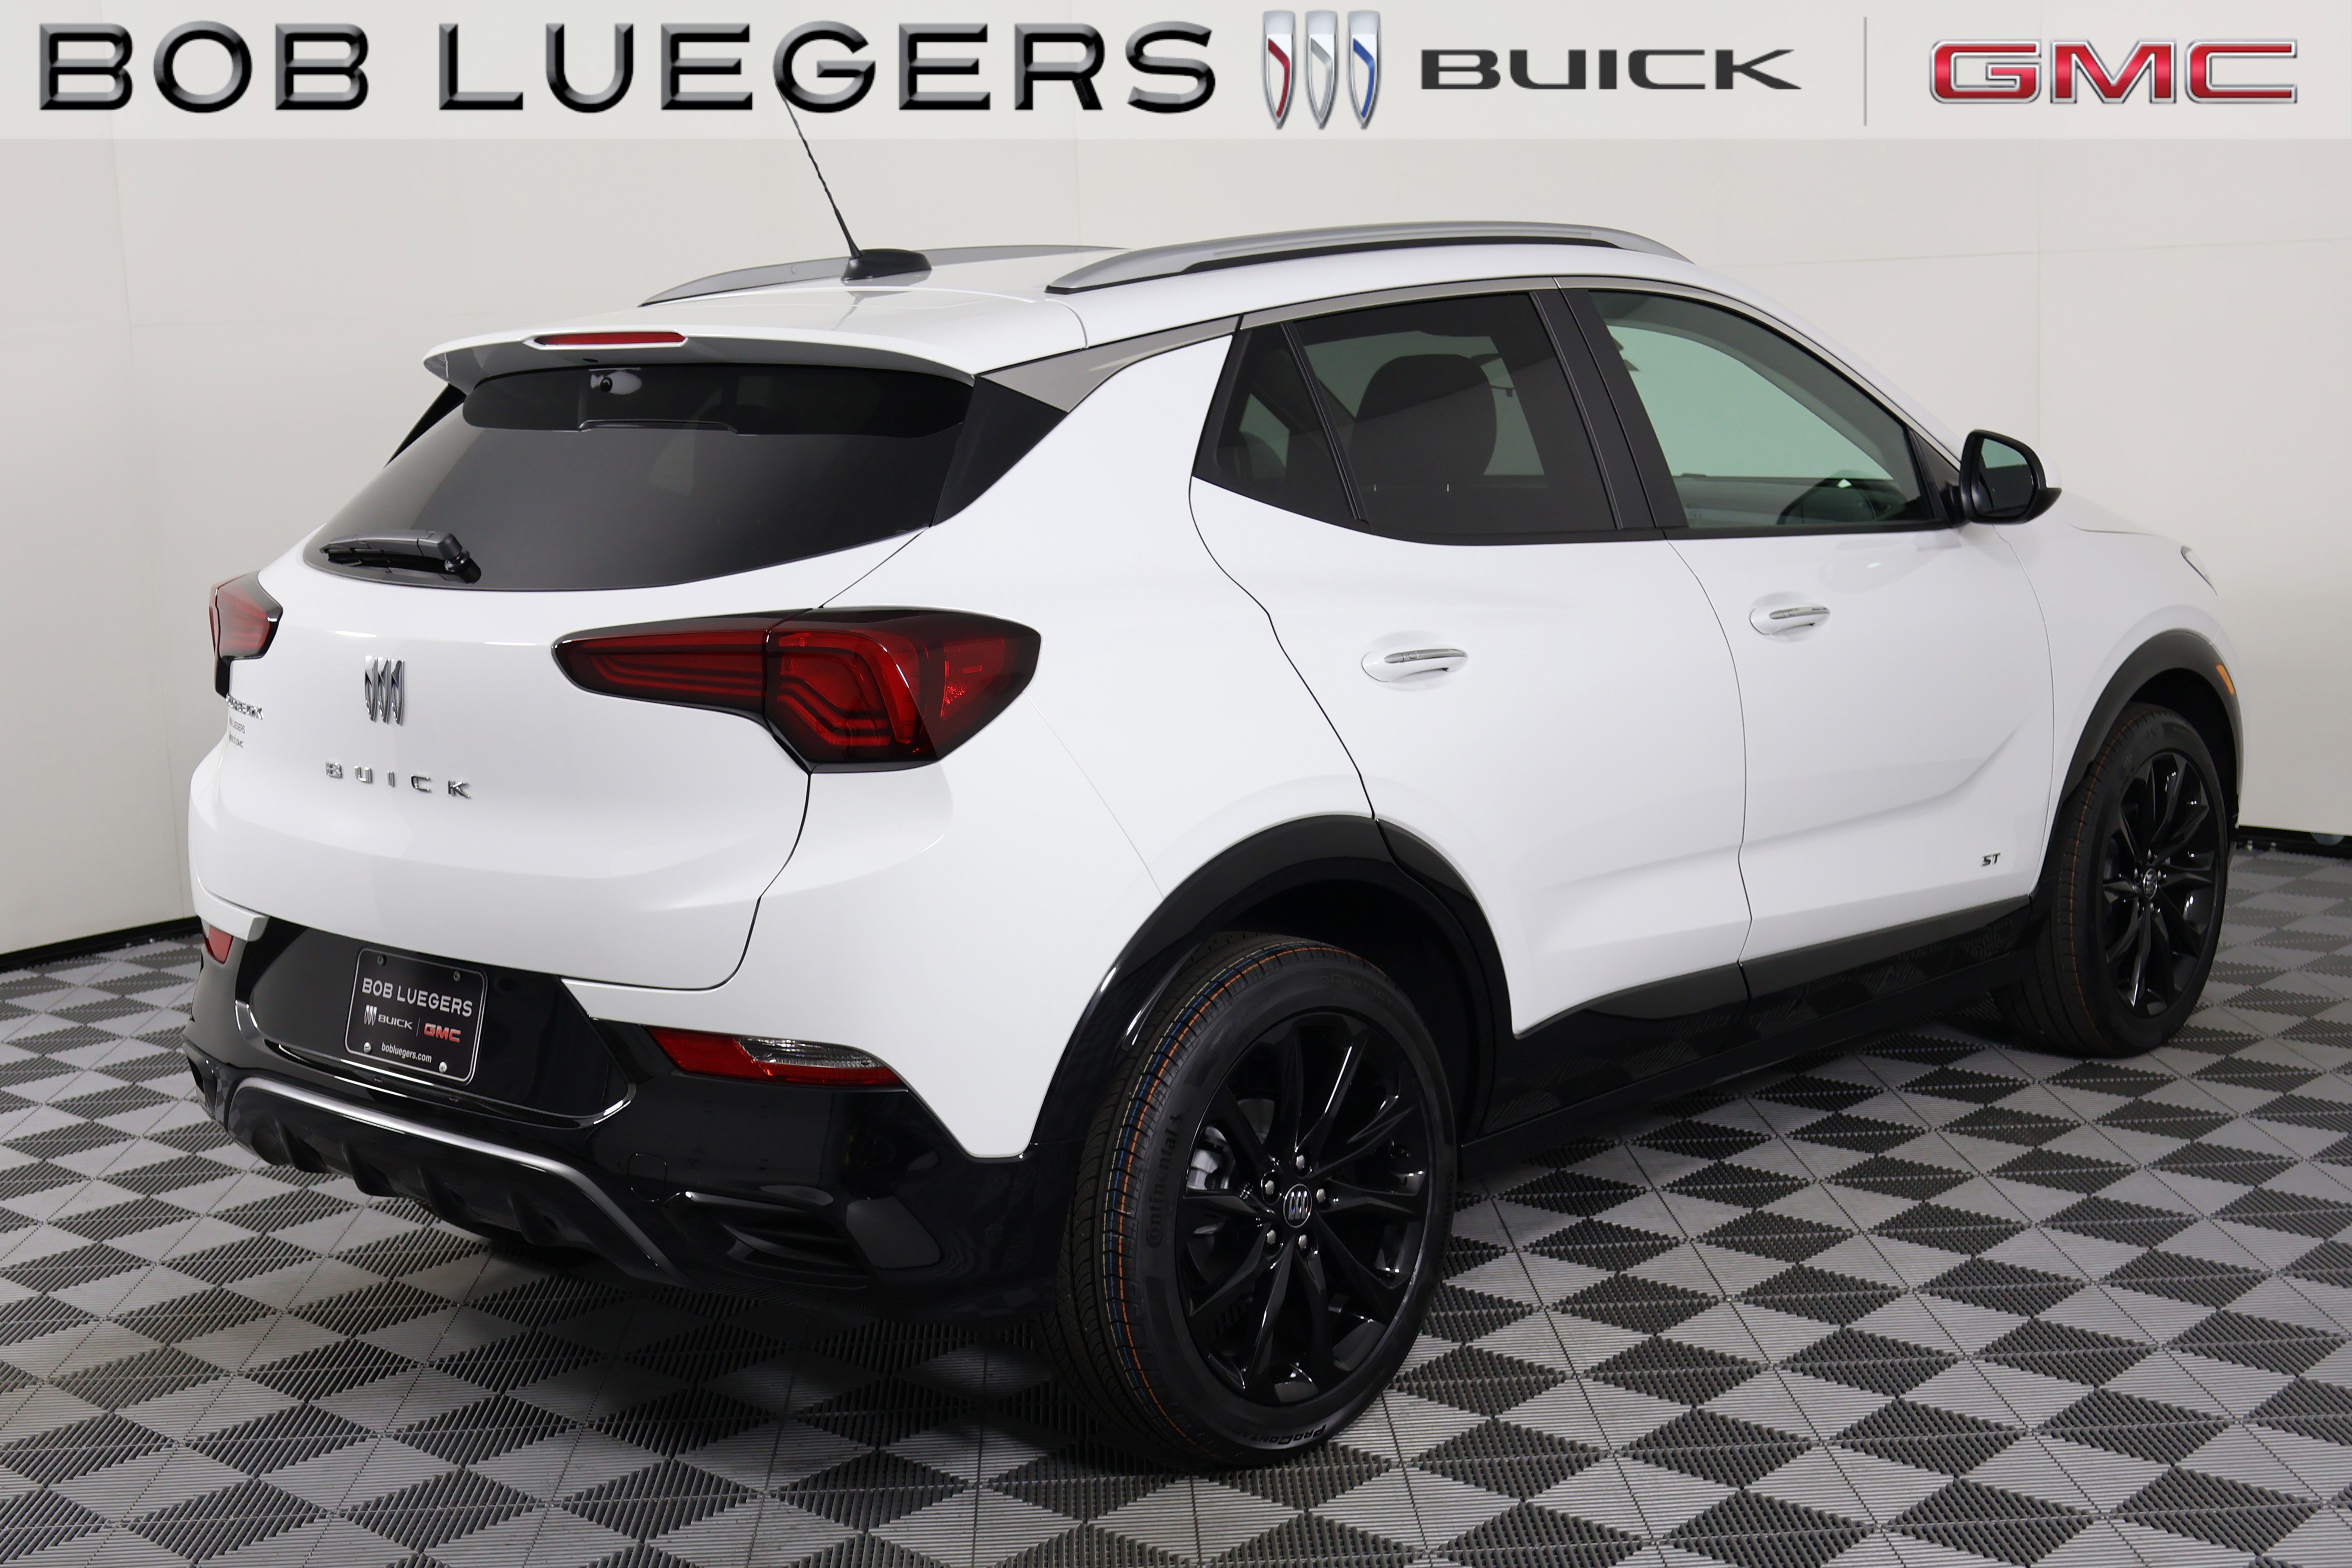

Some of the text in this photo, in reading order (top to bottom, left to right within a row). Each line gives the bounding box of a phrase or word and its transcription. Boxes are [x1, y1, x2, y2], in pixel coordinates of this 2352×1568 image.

[325, 761, 472, 799] BUICK
[1980, 852, 2001, 866] ST
[362, 978, 473, 1017] BOB LUEGERS
[378, 1014, 412, 1030] BUICK
[423, 1022, 461, 1042] GMC
[381, 1042, 432, 1063] bobluegers.com
[1146, 1127, 1178, 1249] Continental
